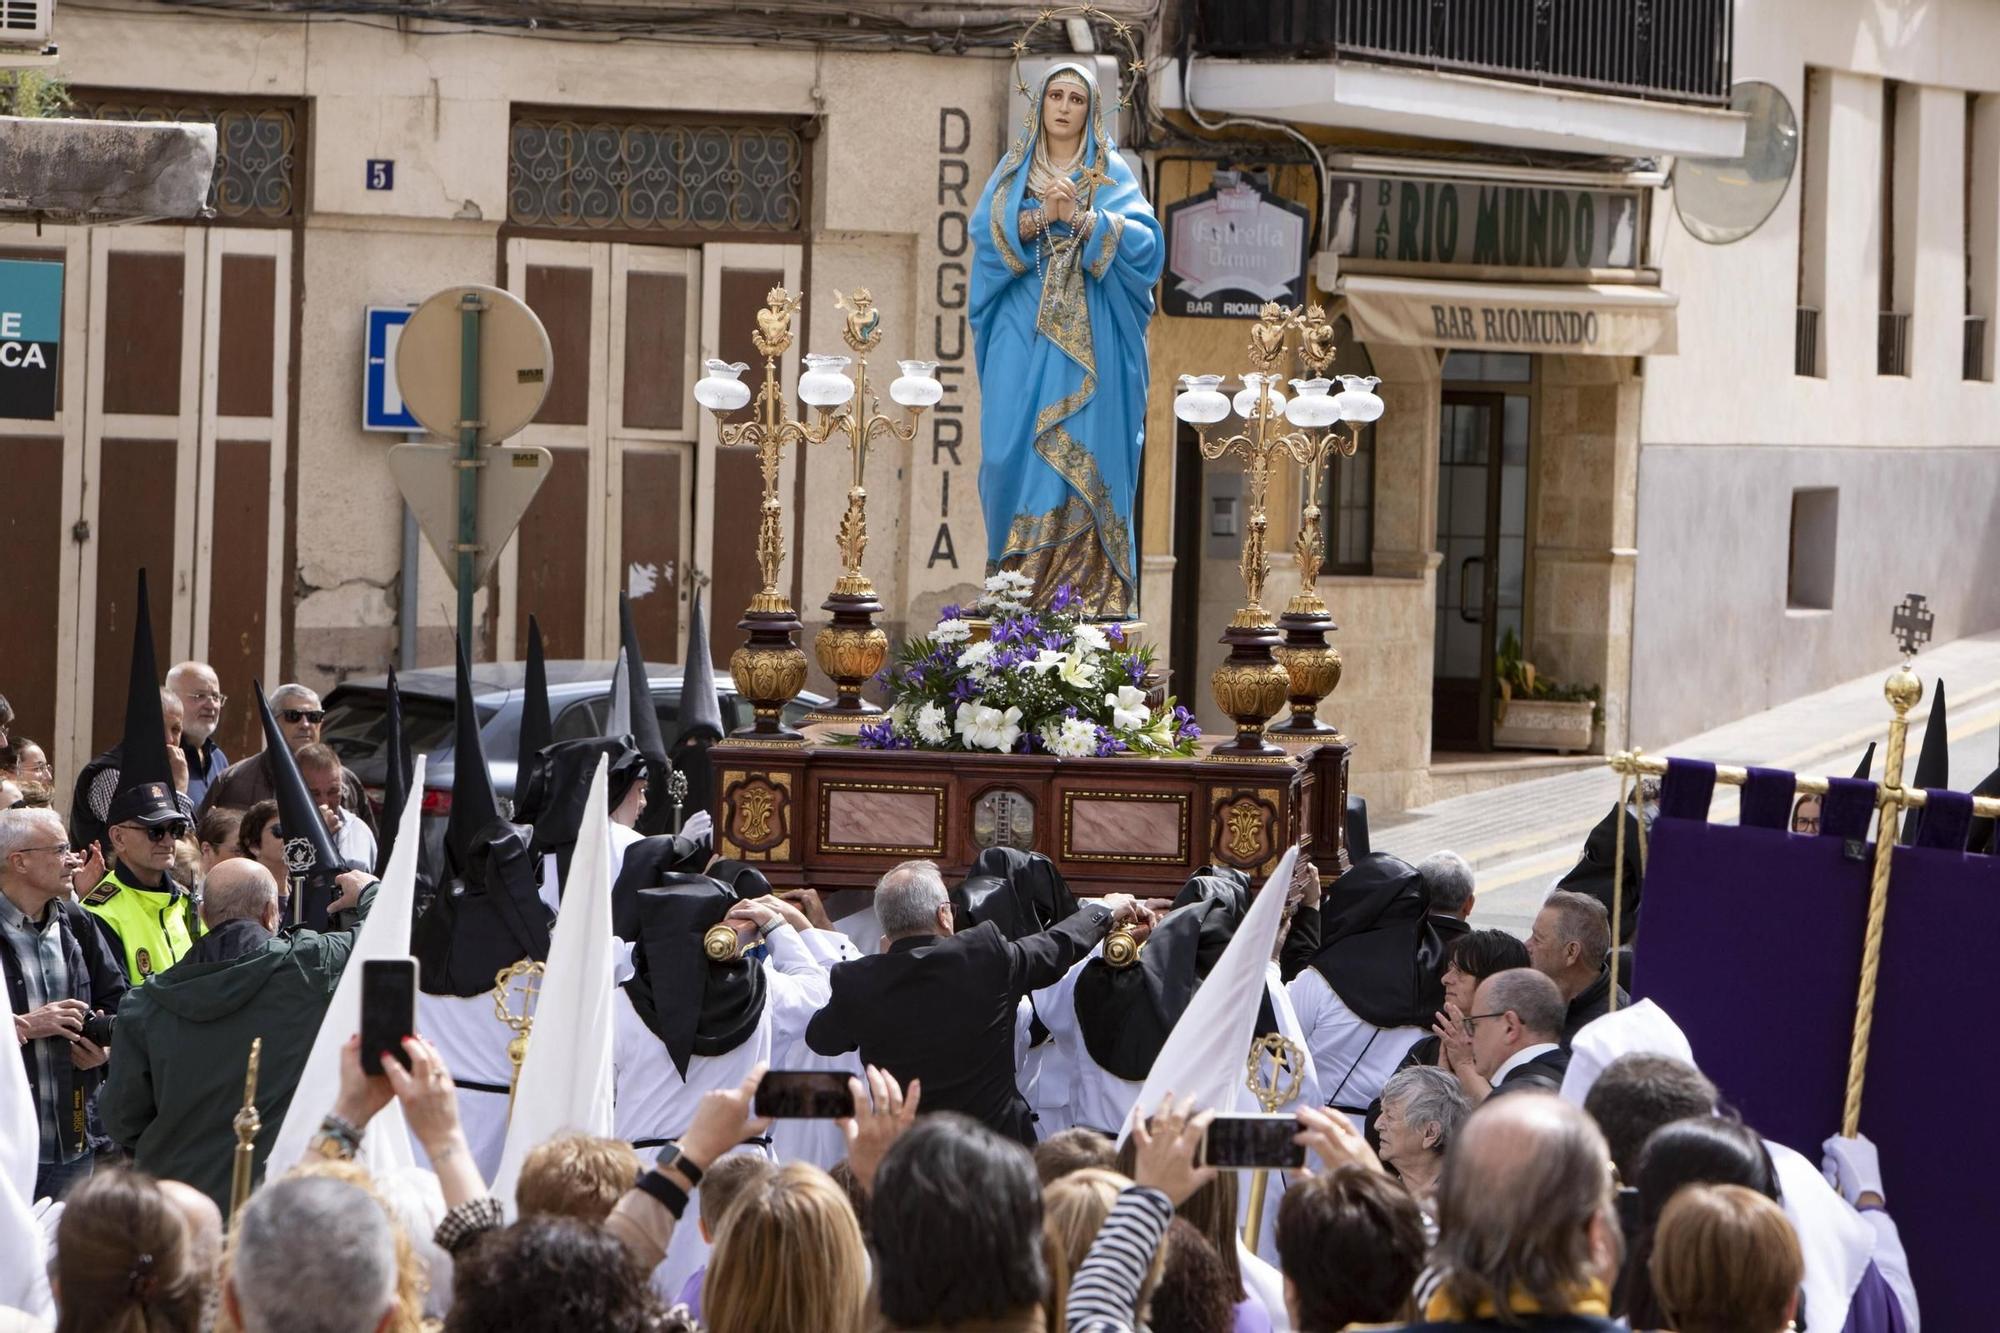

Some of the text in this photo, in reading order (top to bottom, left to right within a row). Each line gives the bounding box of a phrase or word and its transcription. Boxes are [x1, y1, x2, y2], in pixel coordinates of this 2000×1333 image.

[373, 163, 386, 188] 5
[1192, 216, 1284, 248] Estrella
[1374, 179, 1393, 259] BAR
[1398, 181, 1594, 268] RIO MUNDO
[1186, 301, 1213, 314] BAR
[1431, 305, 1598, 346] BAR RIOMUNDO
[927, 107, 971, 569] DROGUERIA
